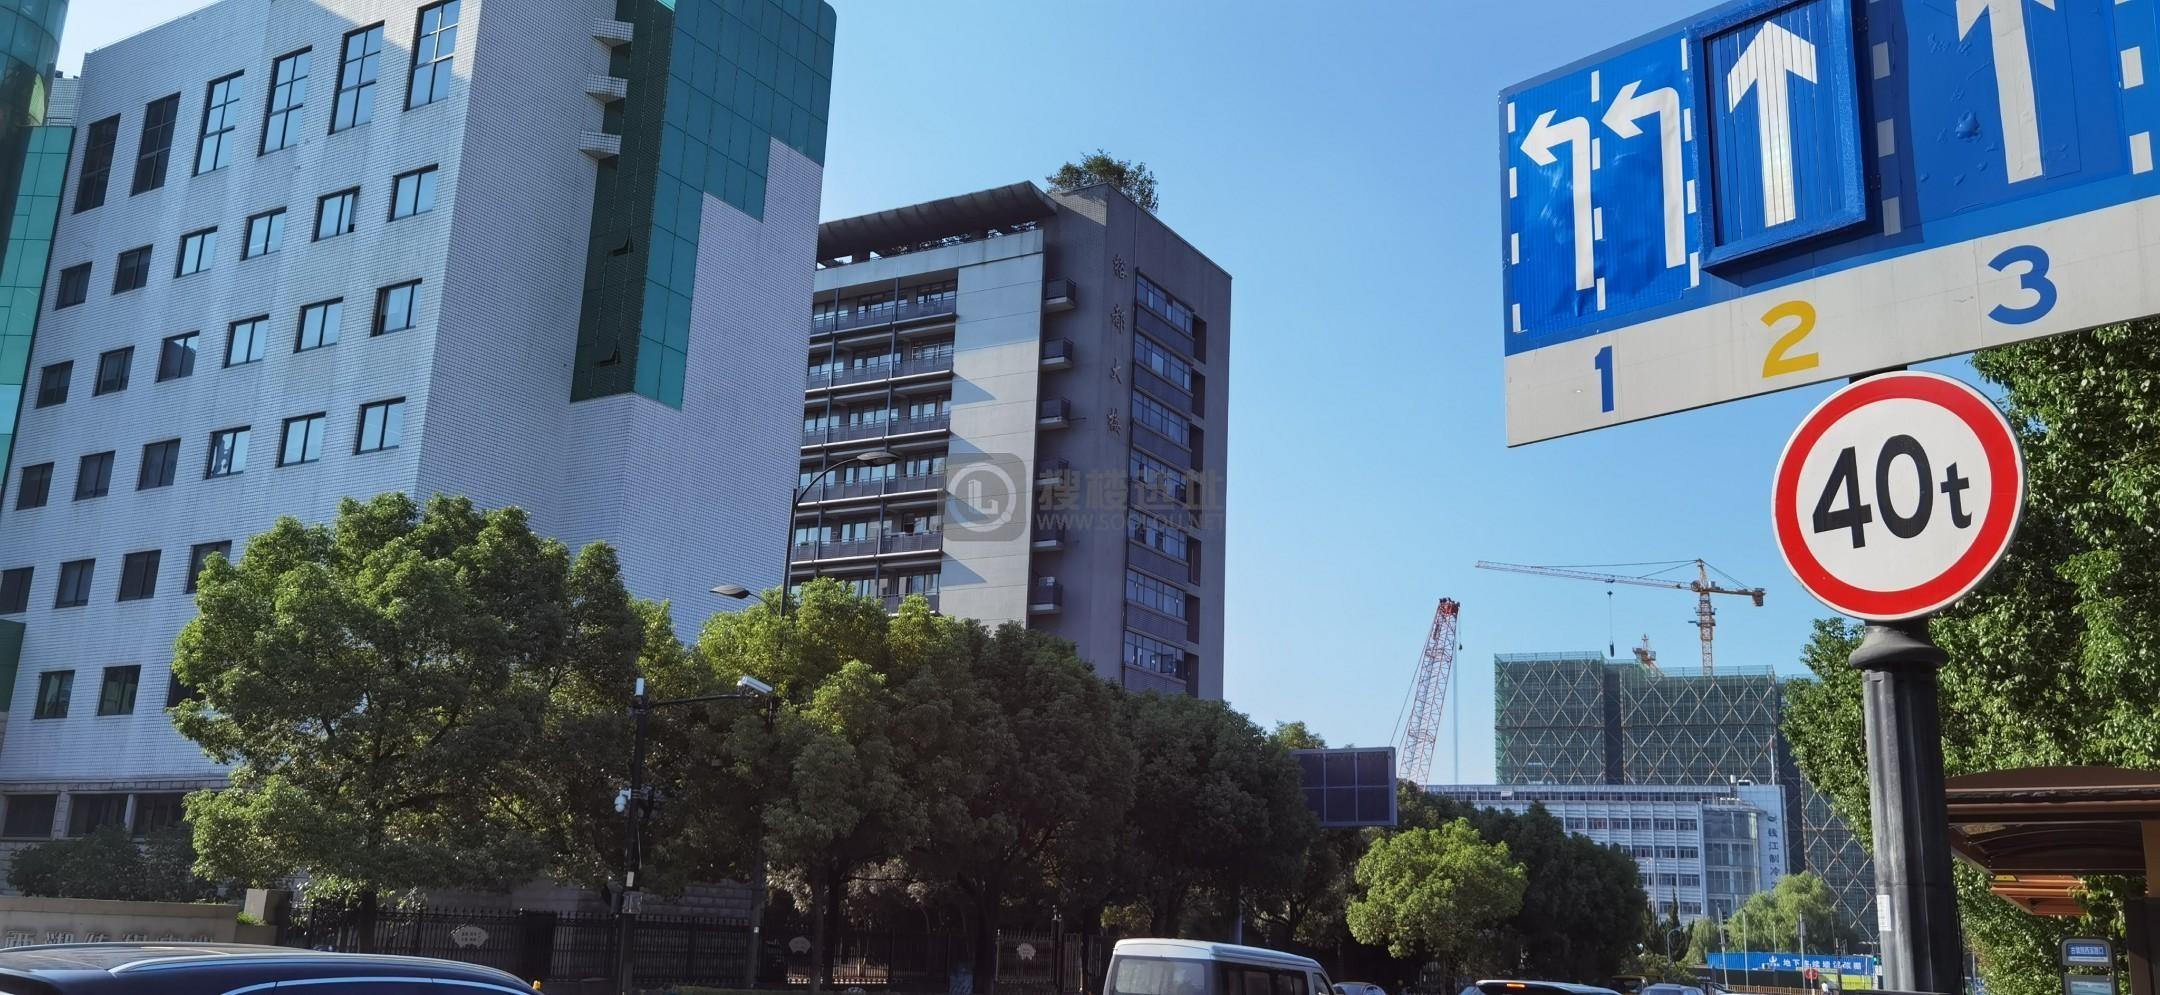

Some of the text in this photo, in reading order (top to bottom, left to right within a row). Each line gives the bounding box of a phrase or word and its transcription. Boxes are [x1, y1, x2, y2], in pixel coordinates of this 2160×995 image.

[1594, 245, 2058, 413] 1 2 3
[1812, 434, 1972, 549] 40t
